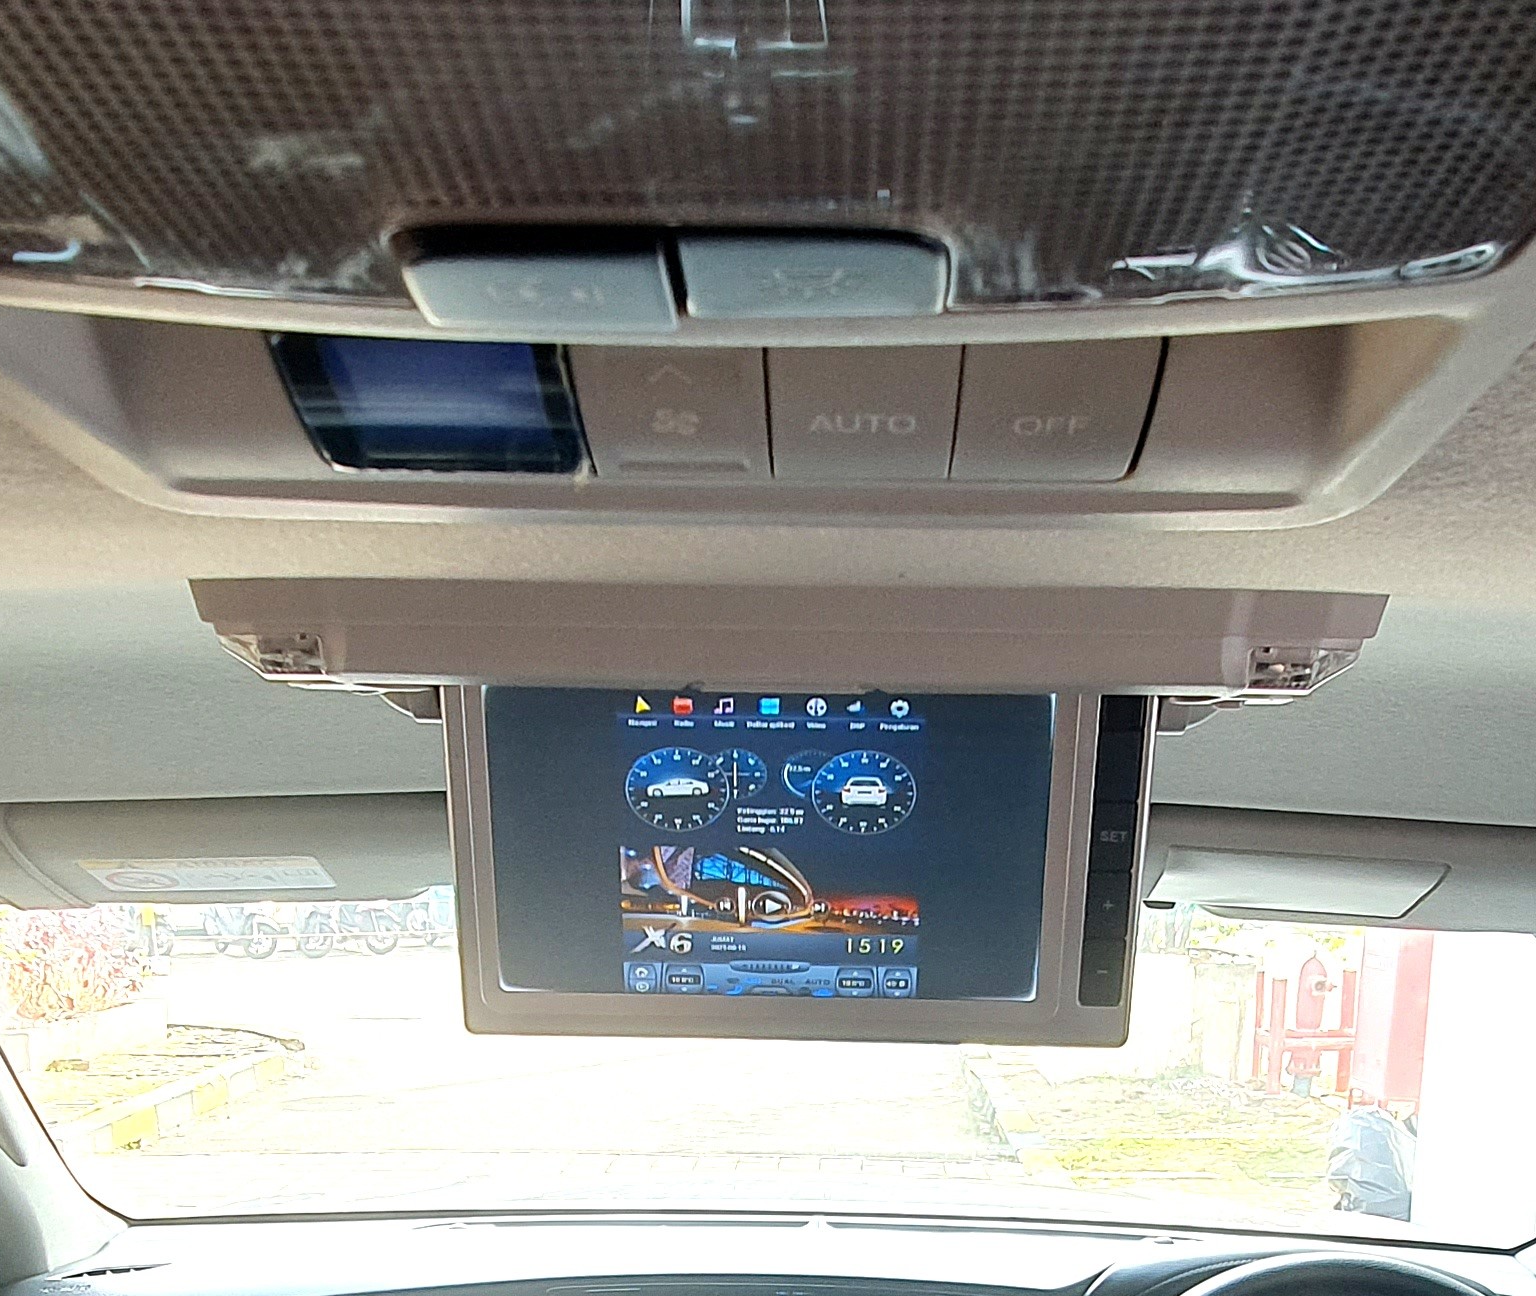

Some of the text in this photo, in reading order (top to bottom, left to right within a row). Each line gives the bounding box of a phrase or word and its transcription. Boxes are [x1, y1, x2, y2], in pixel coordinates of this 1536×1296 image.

[809, 413, 918, 436] AUTO
[1012, 415, 1092, 437] OFF
[1099, 831, 1128, 843] SET
